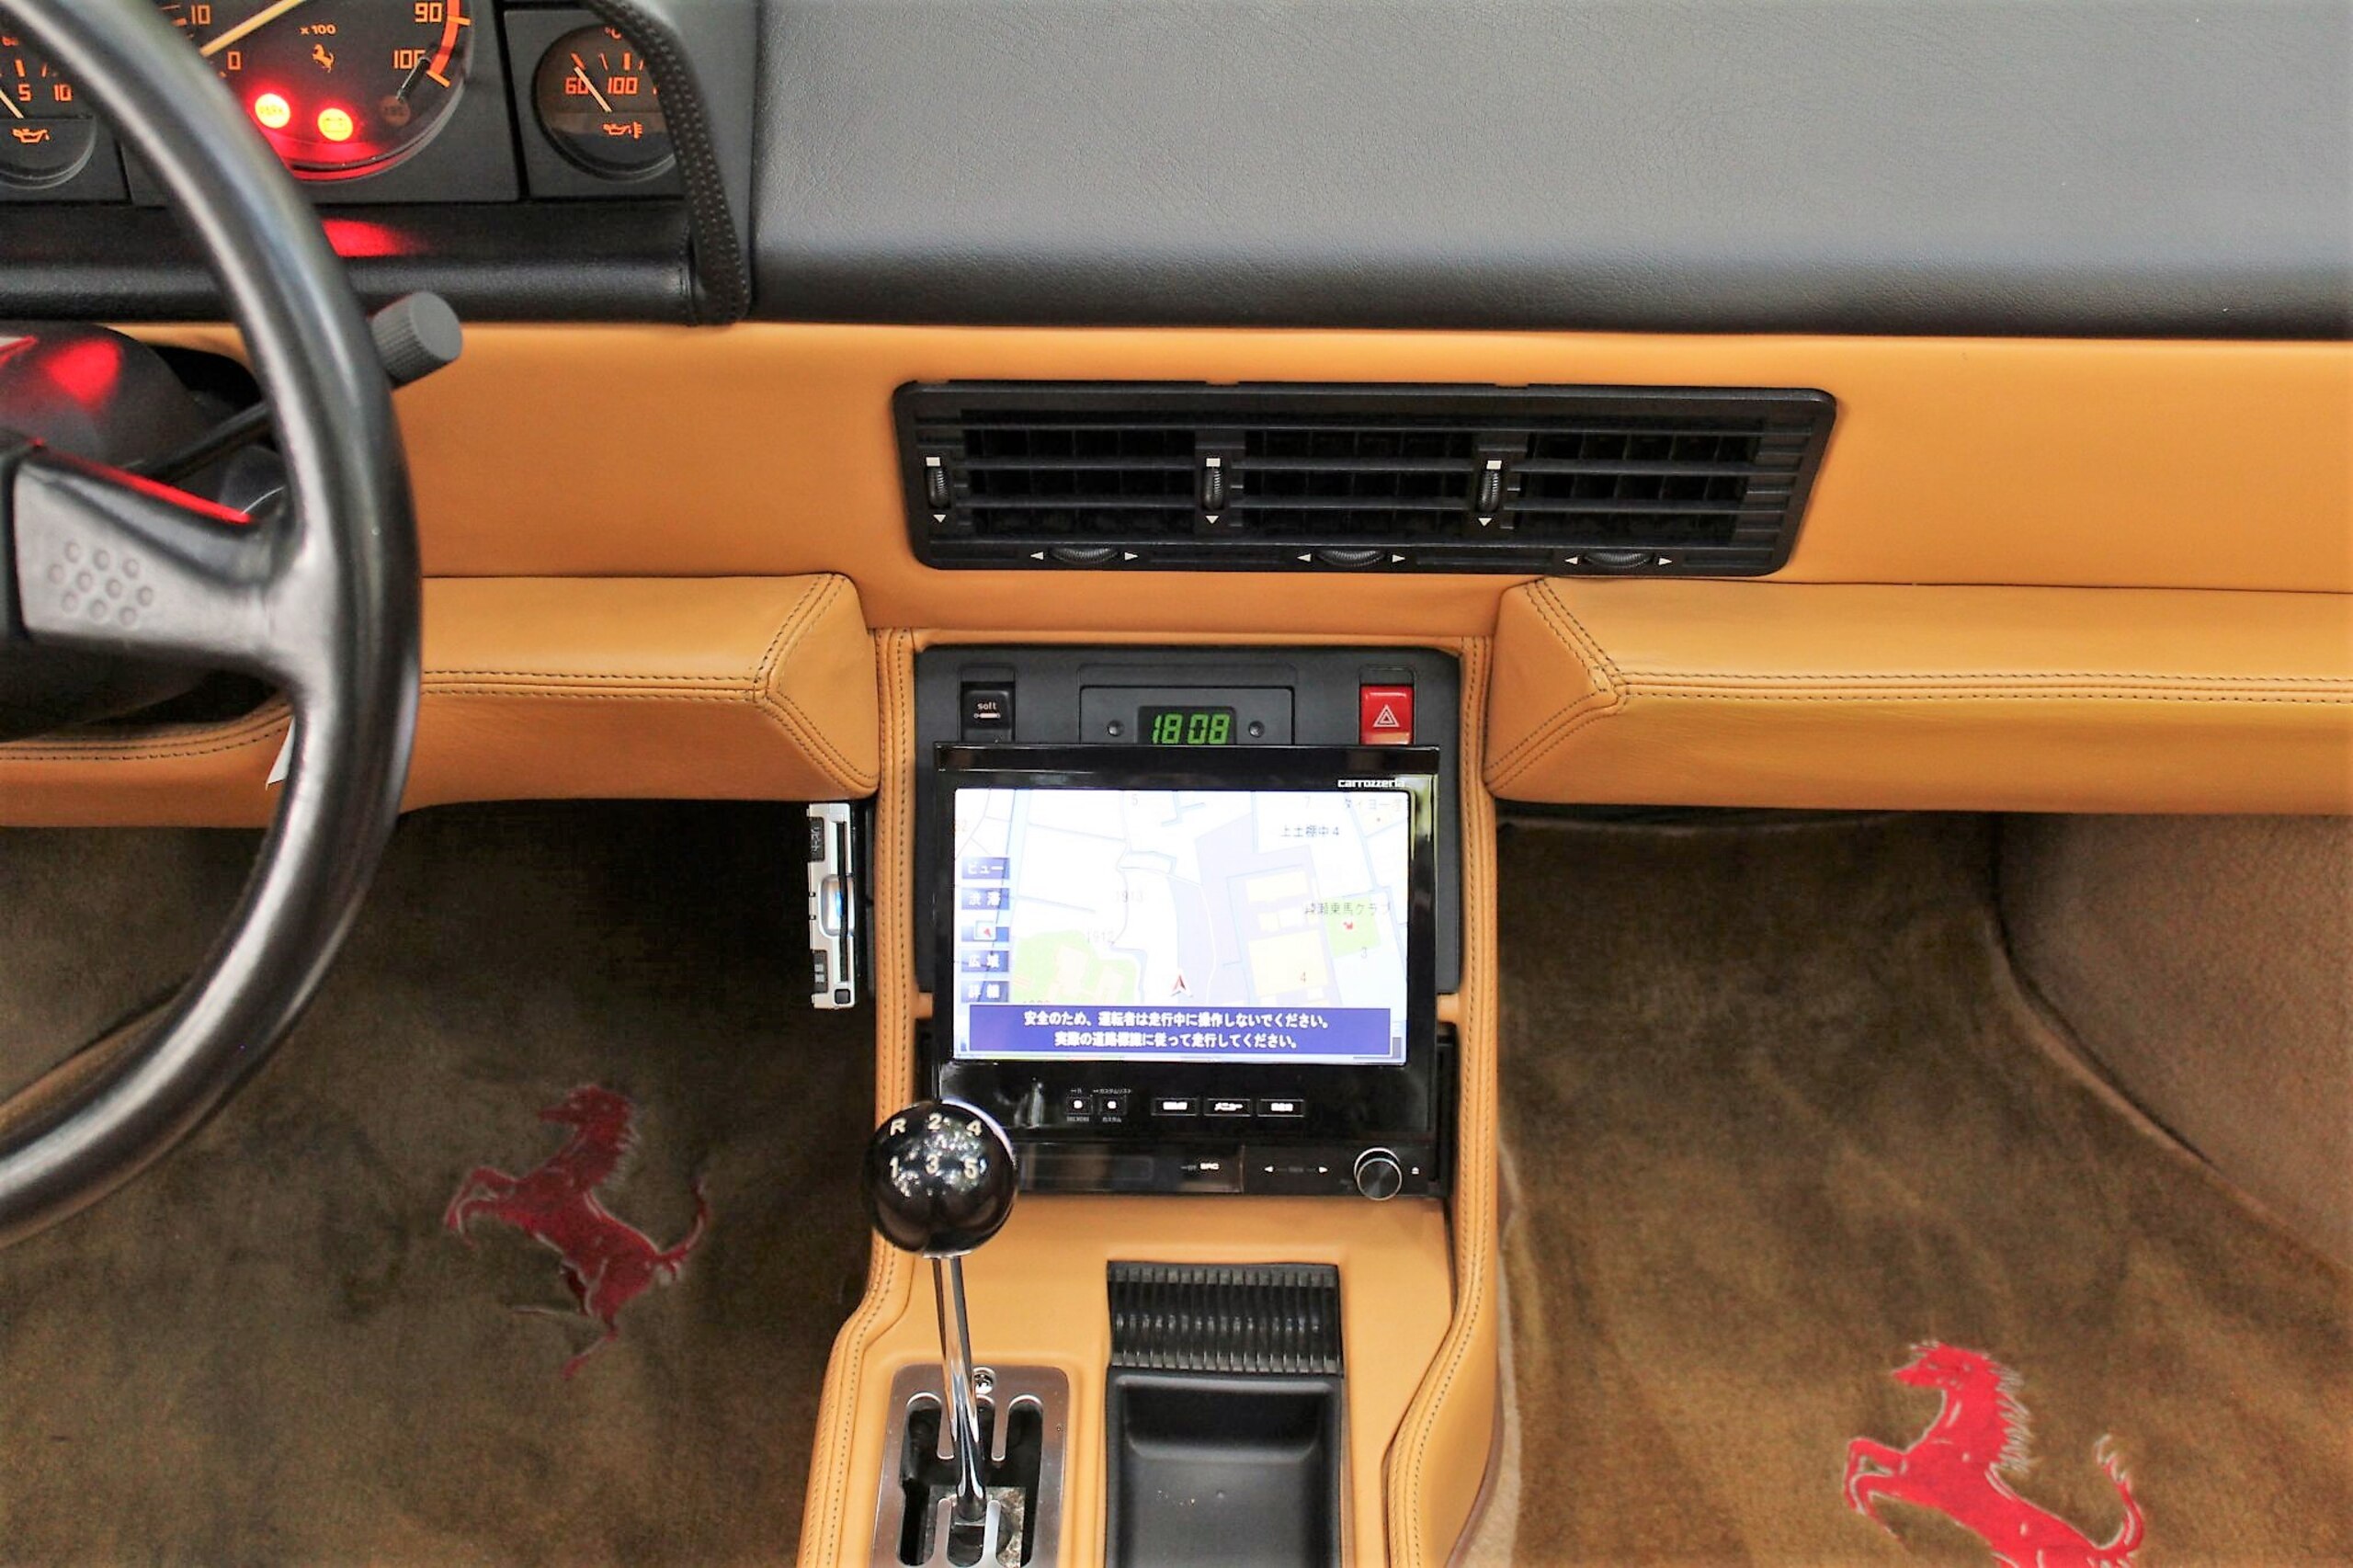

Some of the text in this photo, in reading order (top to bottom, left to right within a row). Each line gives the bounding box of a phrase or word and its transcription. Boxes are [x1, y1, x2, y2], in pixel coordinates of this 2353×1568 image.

[191, 5, 211, 25] 10
[415, 3, 442, 23] 90
[227, 51, 241, 70] 0
[18, 84, 72, 101] 5 10
[608, 77, 638, 94] 100
[1337, 778, 1404, 788] carrozzeria
[968, 861, 1004, 874] ビュー
[890, 1112, 983, 1137] R 2 4
[890, 1153, 978, 1180] 1 3 5
